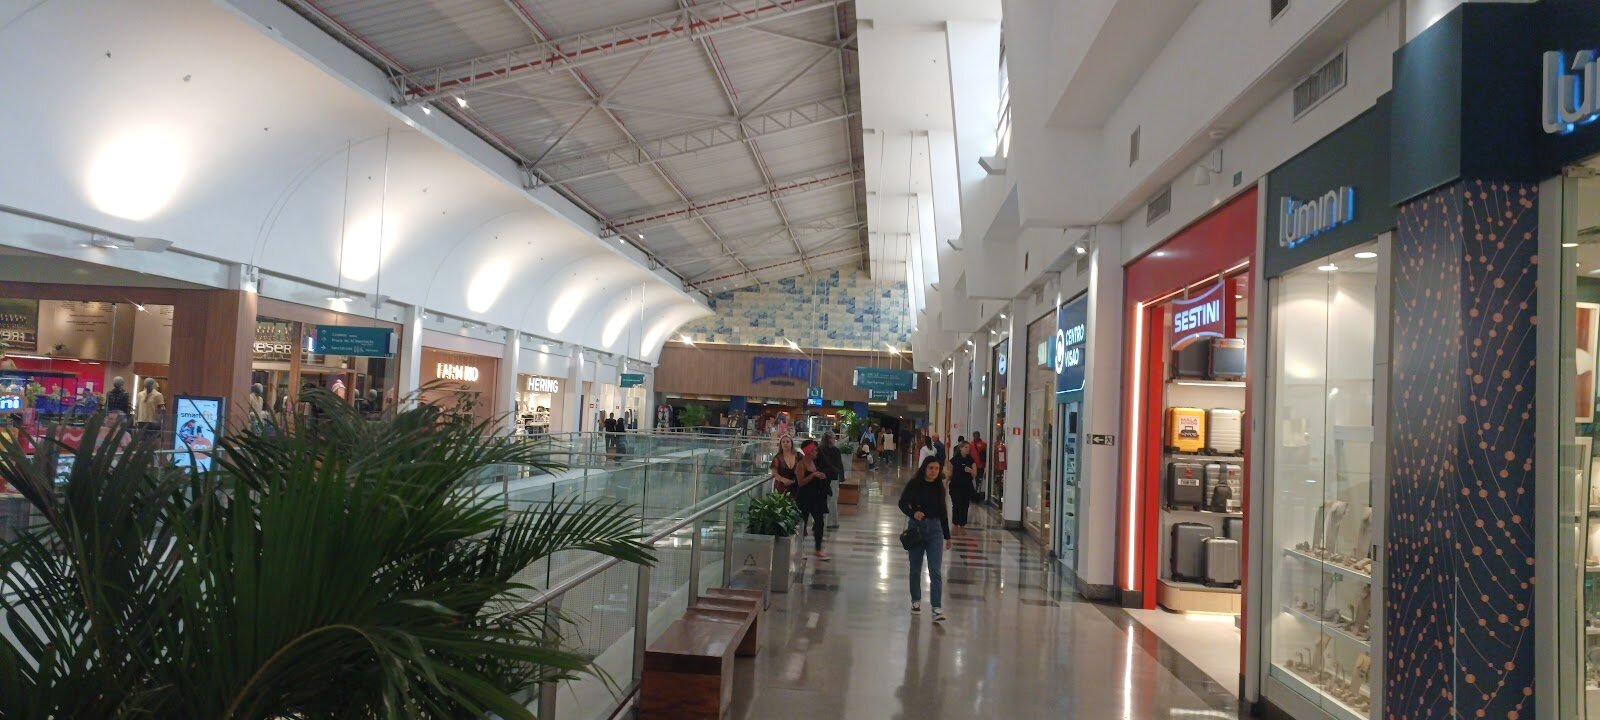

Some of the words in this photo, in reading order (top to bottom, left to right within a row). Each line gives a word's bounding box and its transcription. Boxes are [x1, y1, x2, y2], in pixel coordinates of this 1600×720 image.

[1174, 299, 1220, 333] SESTINI
[1065, 323, 1085, 347] CENTRO
[437, 362, 464, 381] FARM
[464, 365, 479, 382] RIO
[528, 377, 559, 394] HERING
